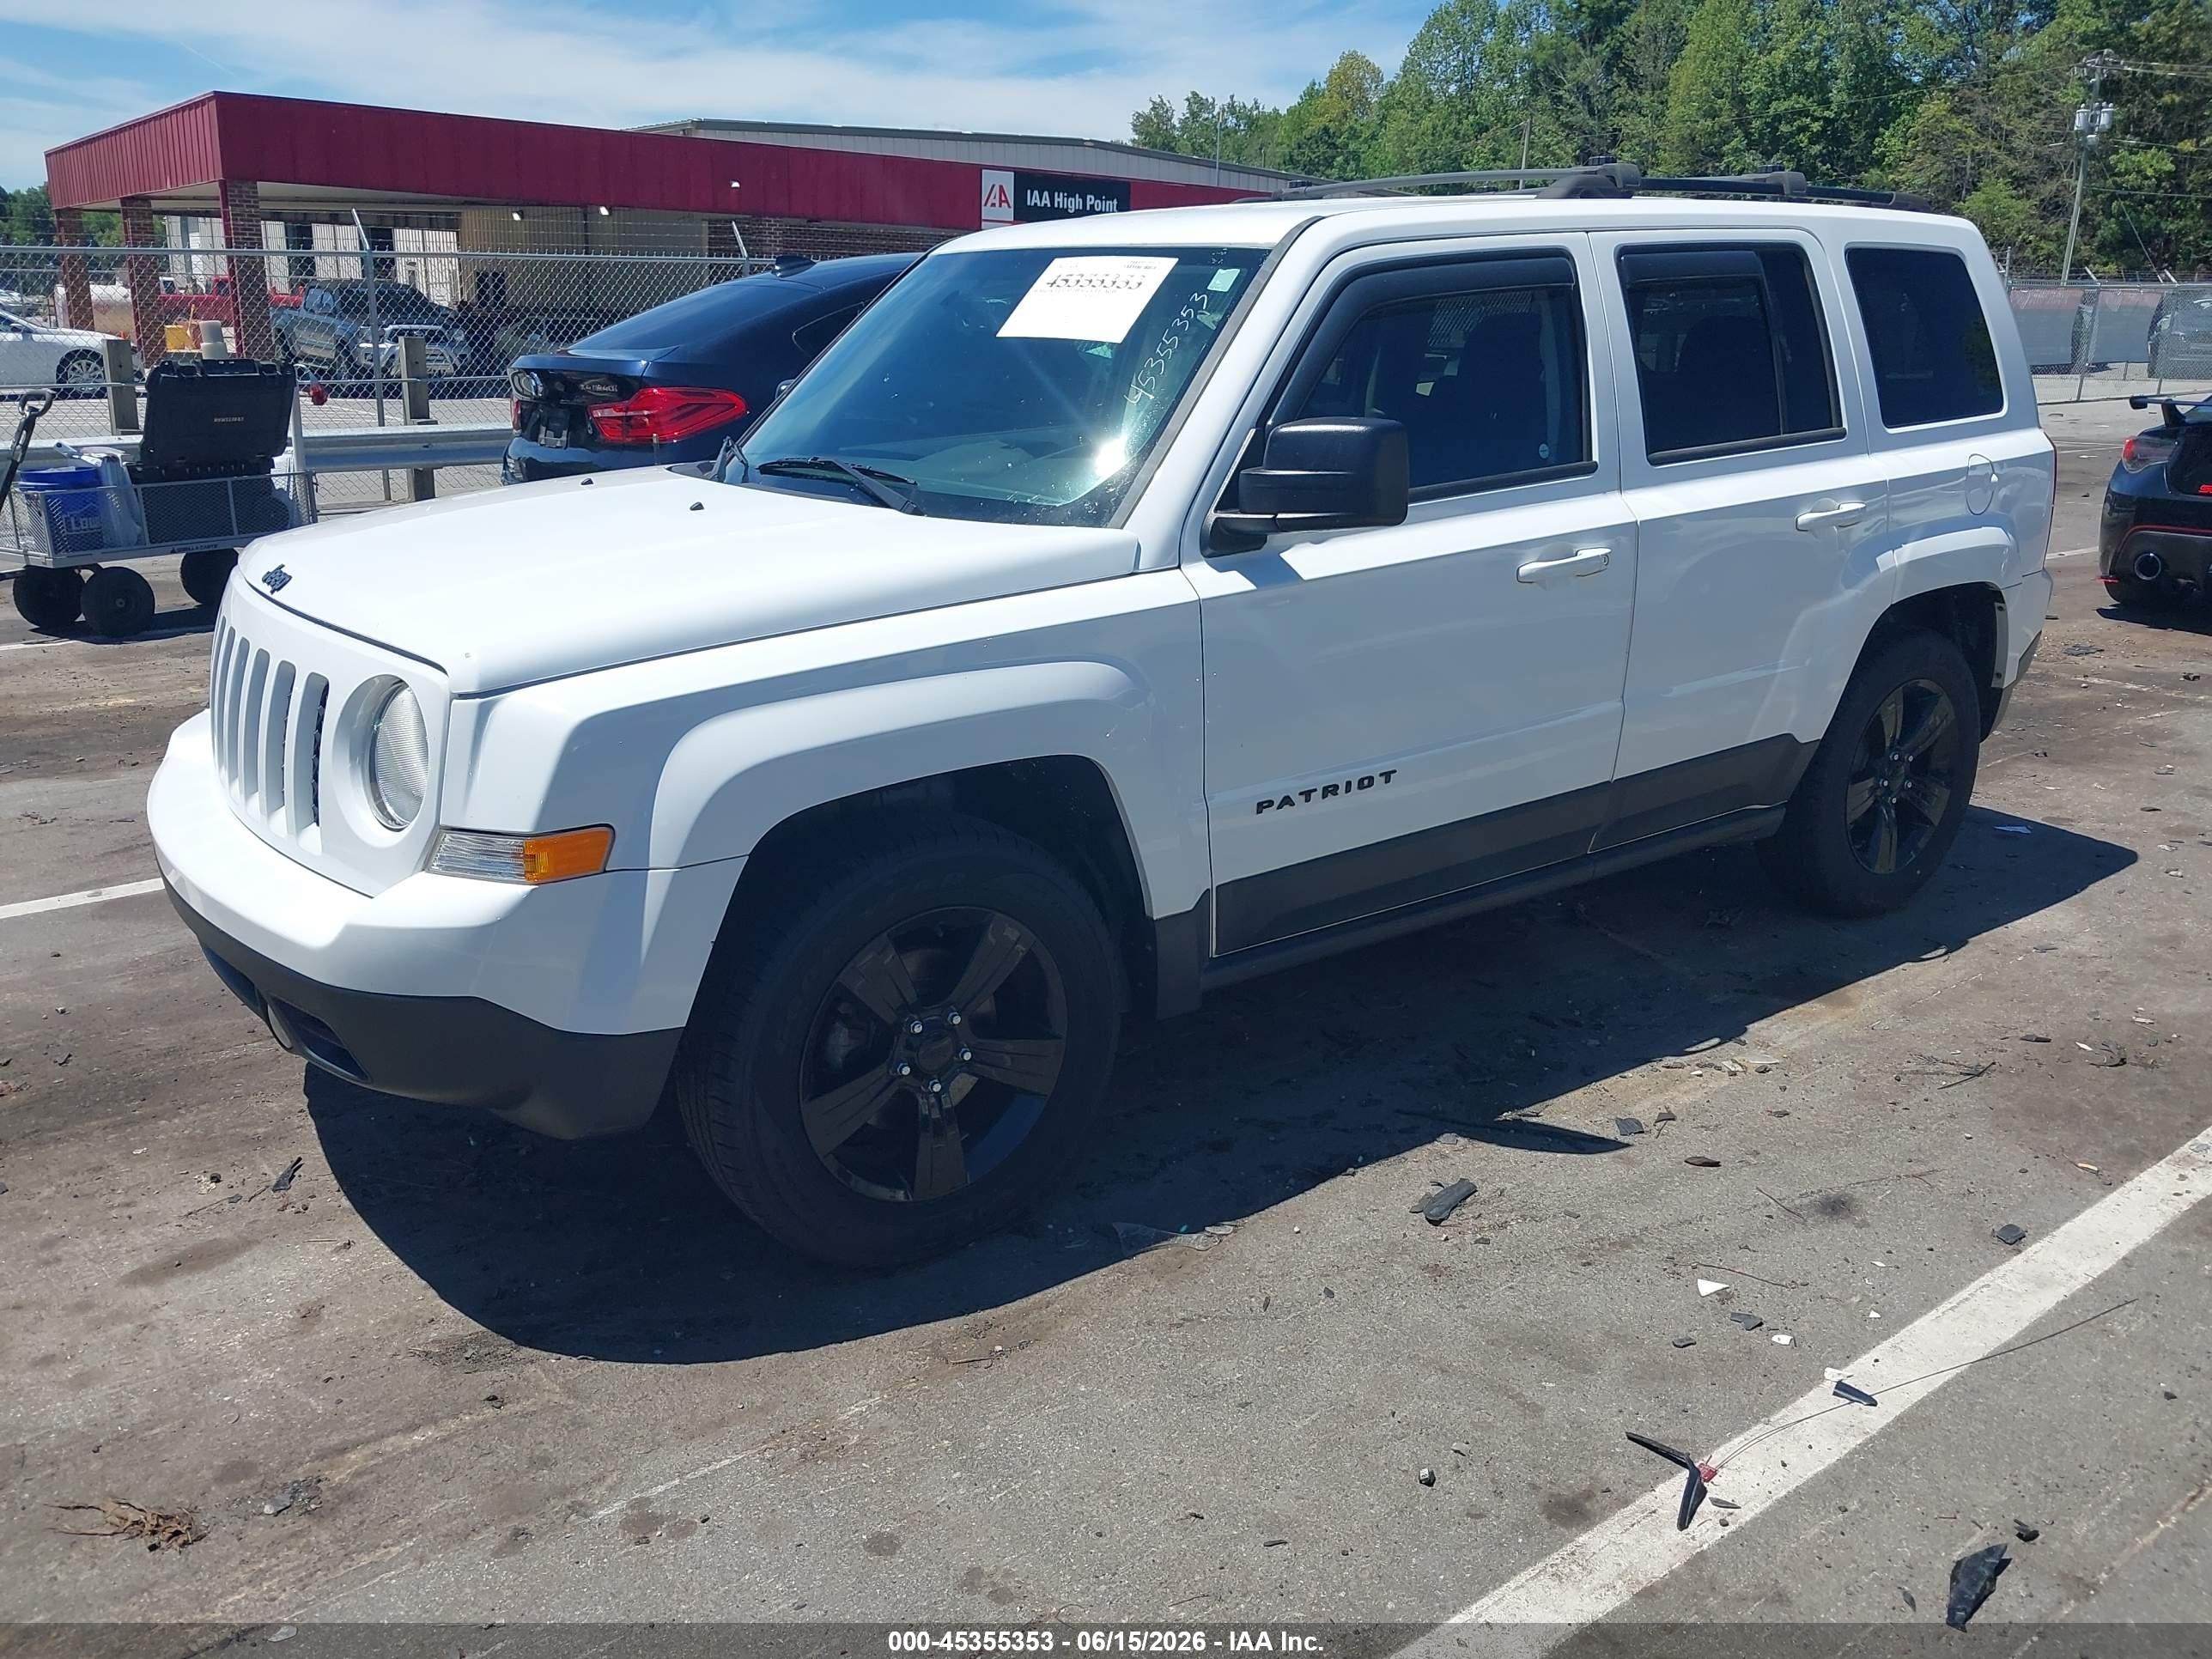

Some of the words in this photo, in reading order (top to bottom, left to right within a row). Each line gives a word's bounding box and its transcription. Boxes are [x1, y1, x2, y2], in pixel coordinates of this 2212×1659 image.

[1026, 189, 1051, 208] IAA
[1054, 191, 1083, 214] High
[1085, 194, 1118, 213] Point
[1123, 292, 1208, 404] 45355353
[1256, 769, 1398, 815] PATRIOT
